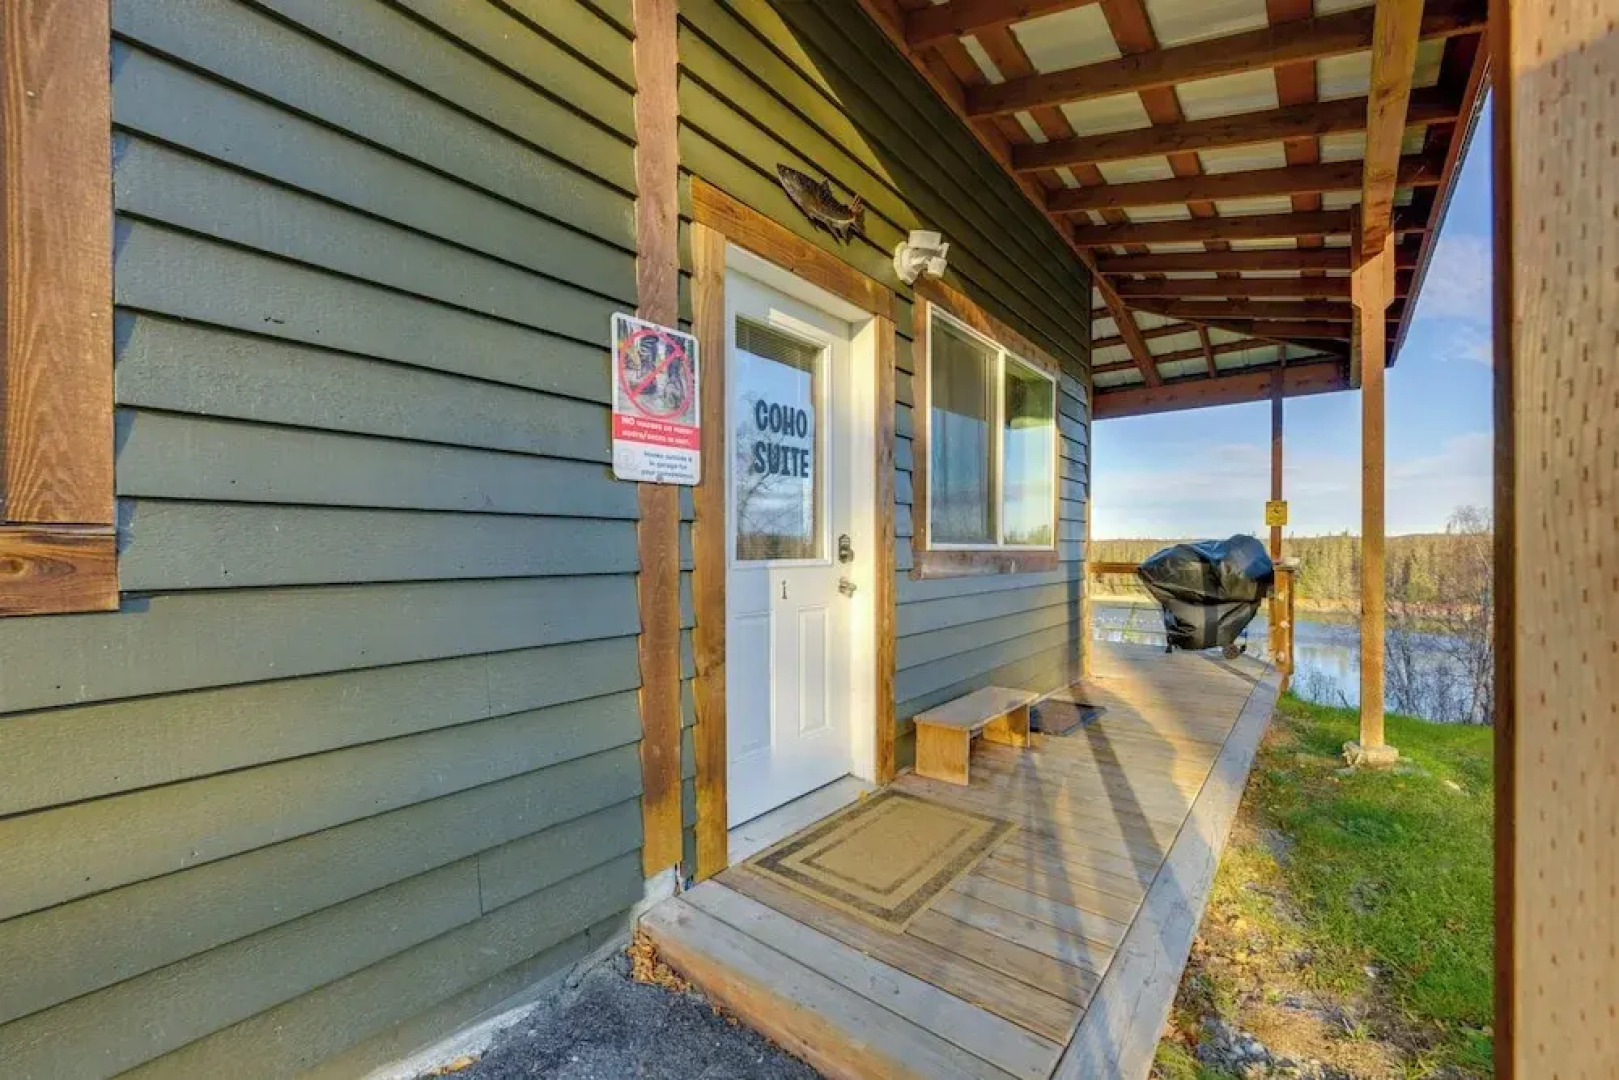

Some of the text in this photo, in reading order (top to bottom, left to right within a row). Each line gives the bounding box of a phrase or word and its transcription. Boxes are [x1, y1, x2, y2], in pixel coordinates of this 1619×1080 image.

[621, 416, 635, 425] NO
[755, 400, 808, 438] COHO
[754, 441, 809, 478] SUITE
